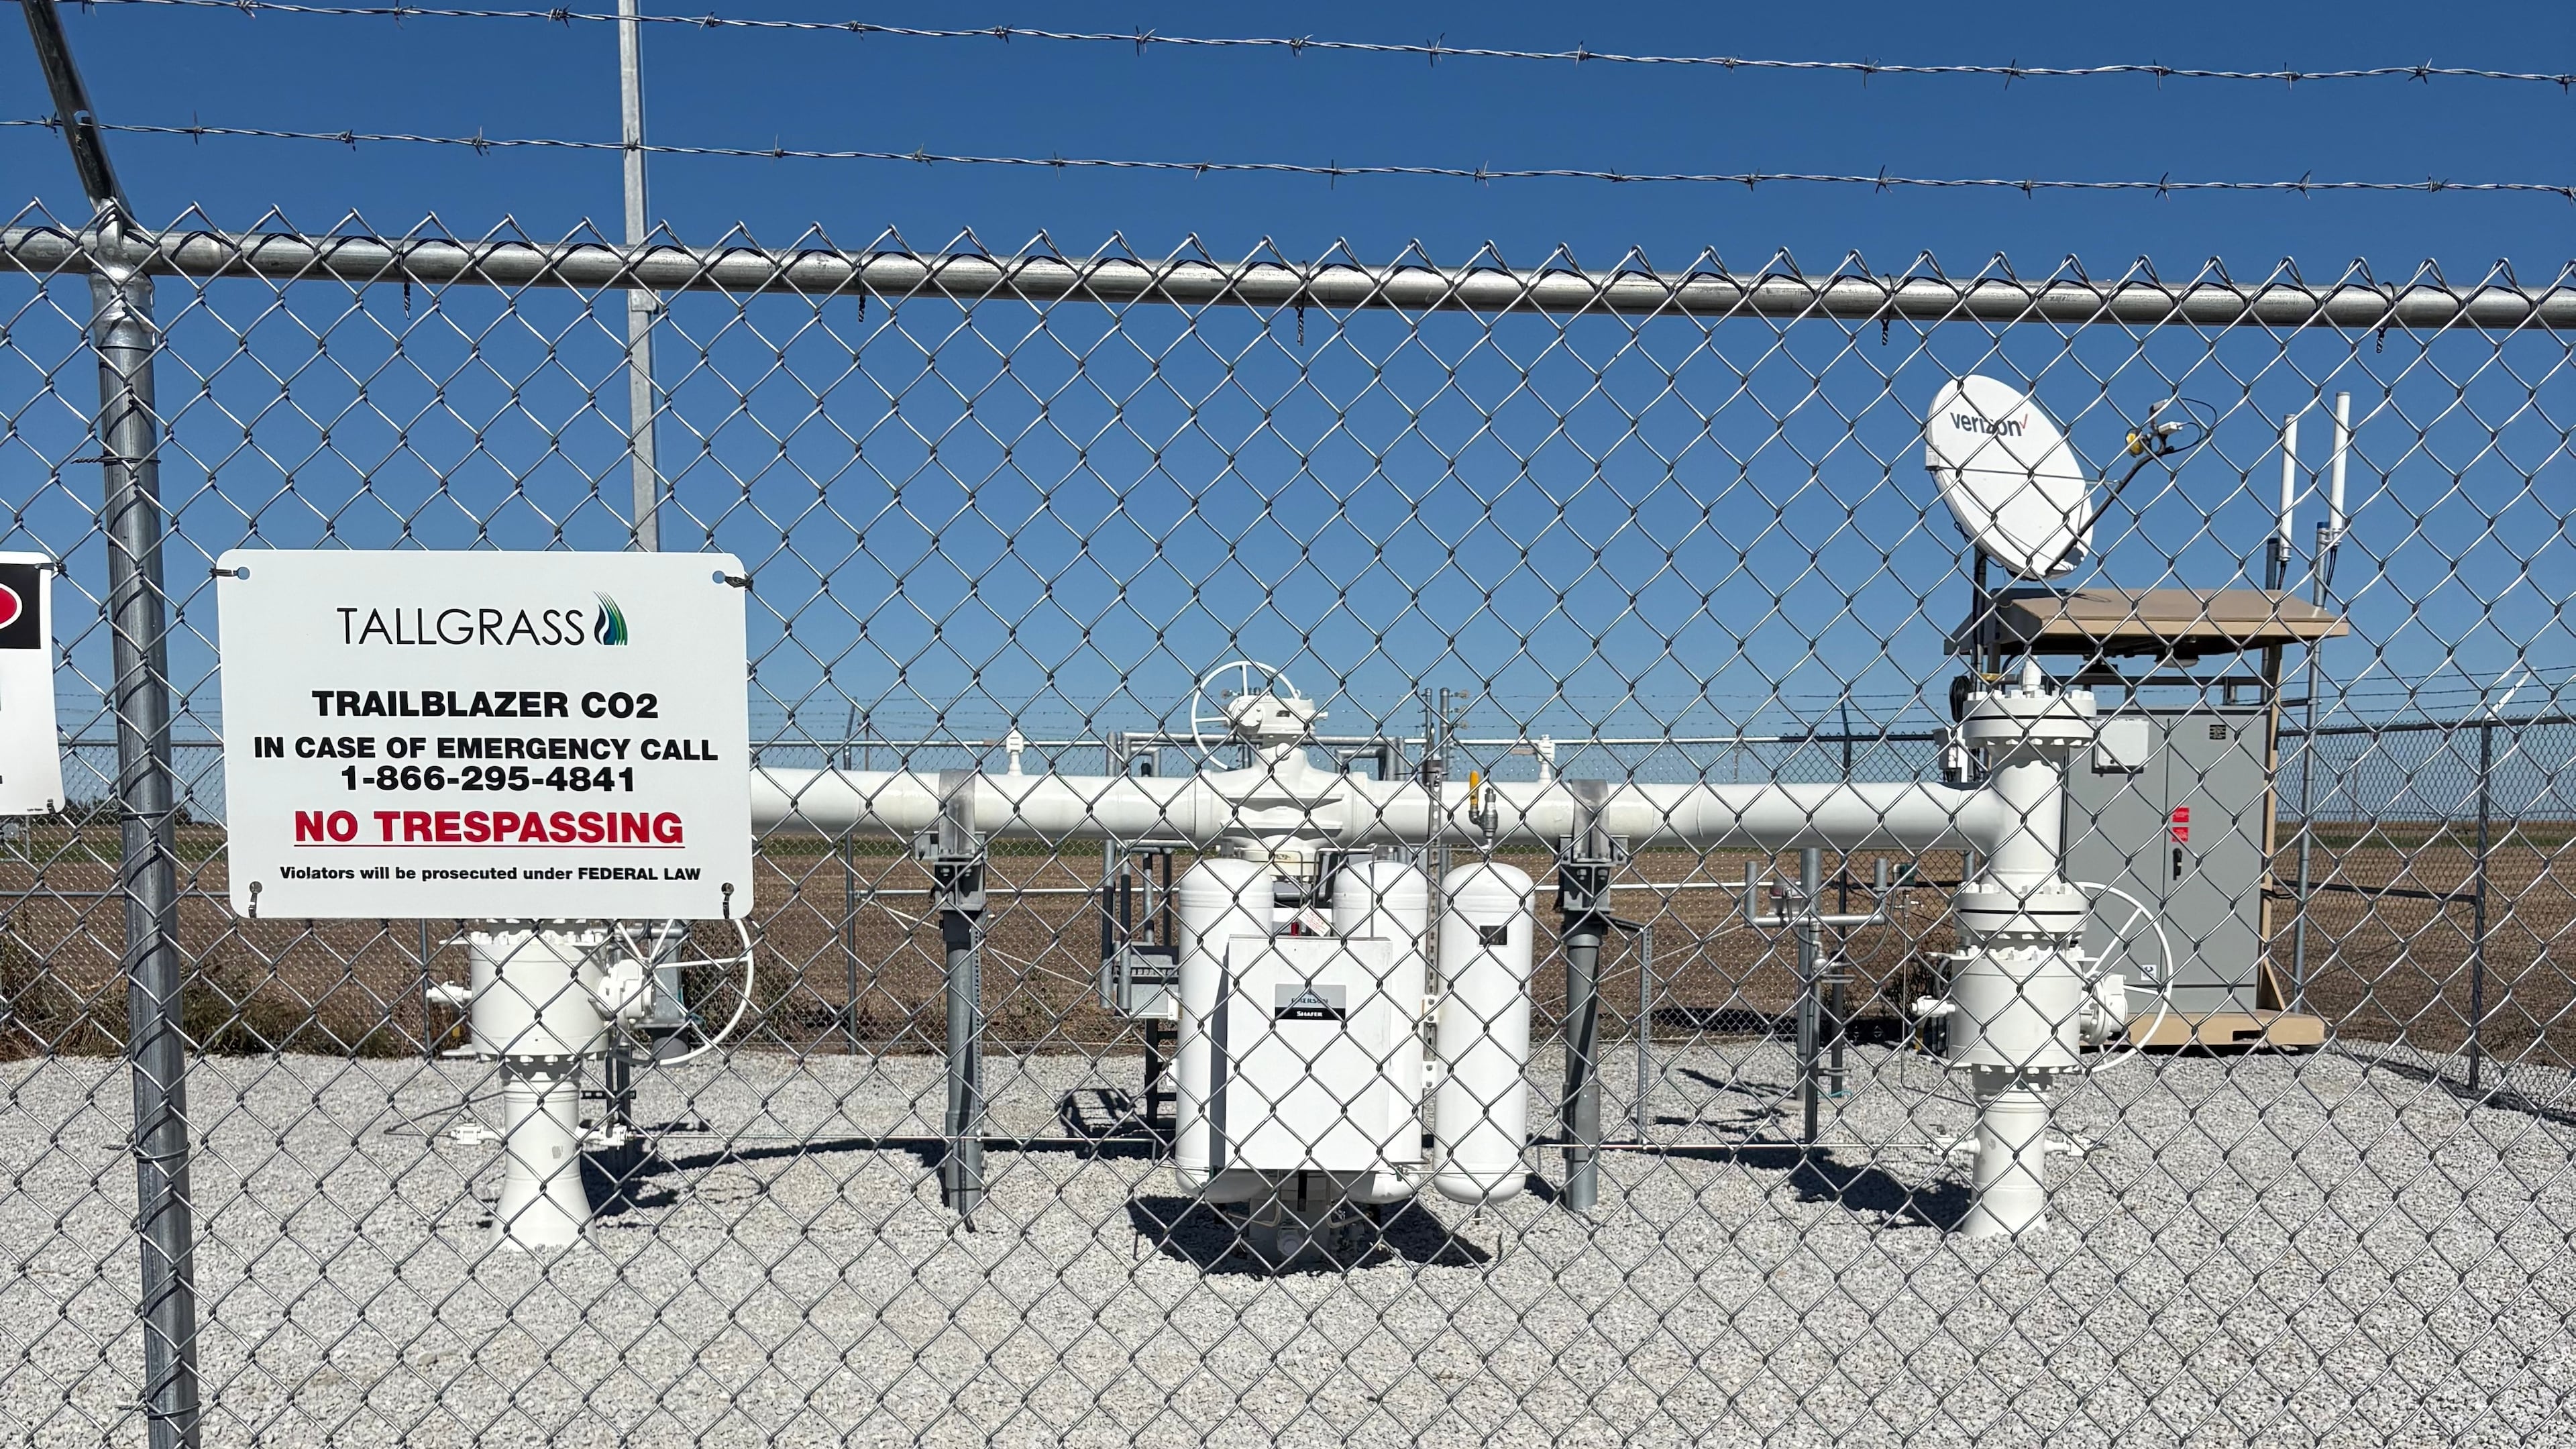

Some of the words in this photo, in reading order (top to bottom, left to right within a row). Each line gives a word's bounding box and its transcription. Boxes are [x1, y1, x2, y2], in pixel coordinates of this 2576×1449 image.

[336, 607, 585, 646] TALLGRASS
[311, 690, 569, 718] TRAILBLAZER
[581, 692, 659, 719] CO2
[254, 737, 284, 758] IN
[294, 737, 376, 759] CASE
[386, 737, 427, 759] OF
[437, 737, 631, 760] EMERGENCY
[641, 739, 718, 761] CALL
[341, 765, 634, 792] 1-866-295-4841
[294, 810, 358, 843] NO
[373, 810, 684, 844] TRESPASSING
[279, 866, 355, 879] Violators
[360, 866, 390, 879] will
[395, 866, 417, 879] be
[421, 867, 518, 882] prosecuted
[523, 867, 574, 880] under
[578, 867, 659, 880] FEDERAL
[663, 867, 701, 881] LAW
